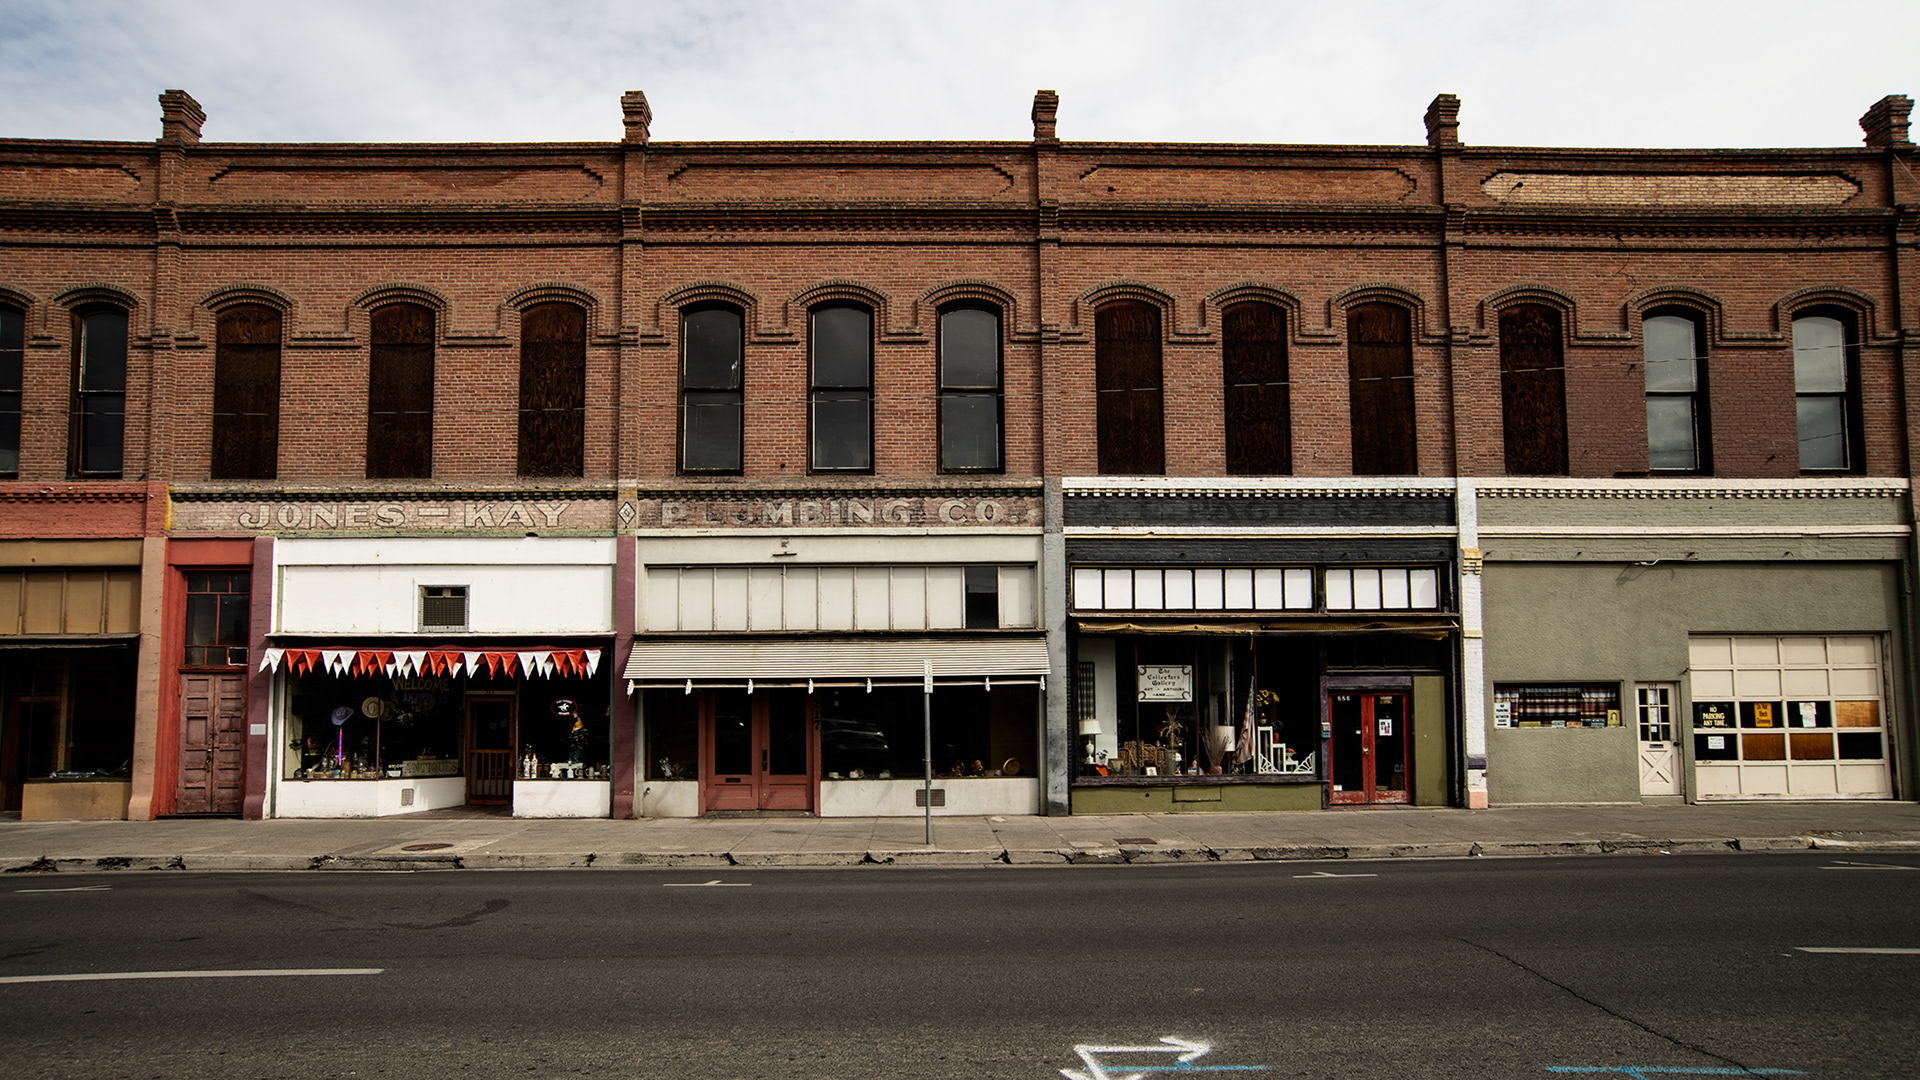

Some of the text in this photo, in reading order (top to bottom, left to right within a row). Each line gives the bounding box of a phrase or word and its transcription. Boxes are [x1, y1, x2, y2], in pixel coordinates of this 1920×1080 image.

[238, 503, 406, 529] JONES
[464, 502, 571, 528] KAY
[661, 501, 914, 526] PLUMBING
[391, 676, 450, 692] WELCOME
[404, 762, 457, 773] ANTIQUES
